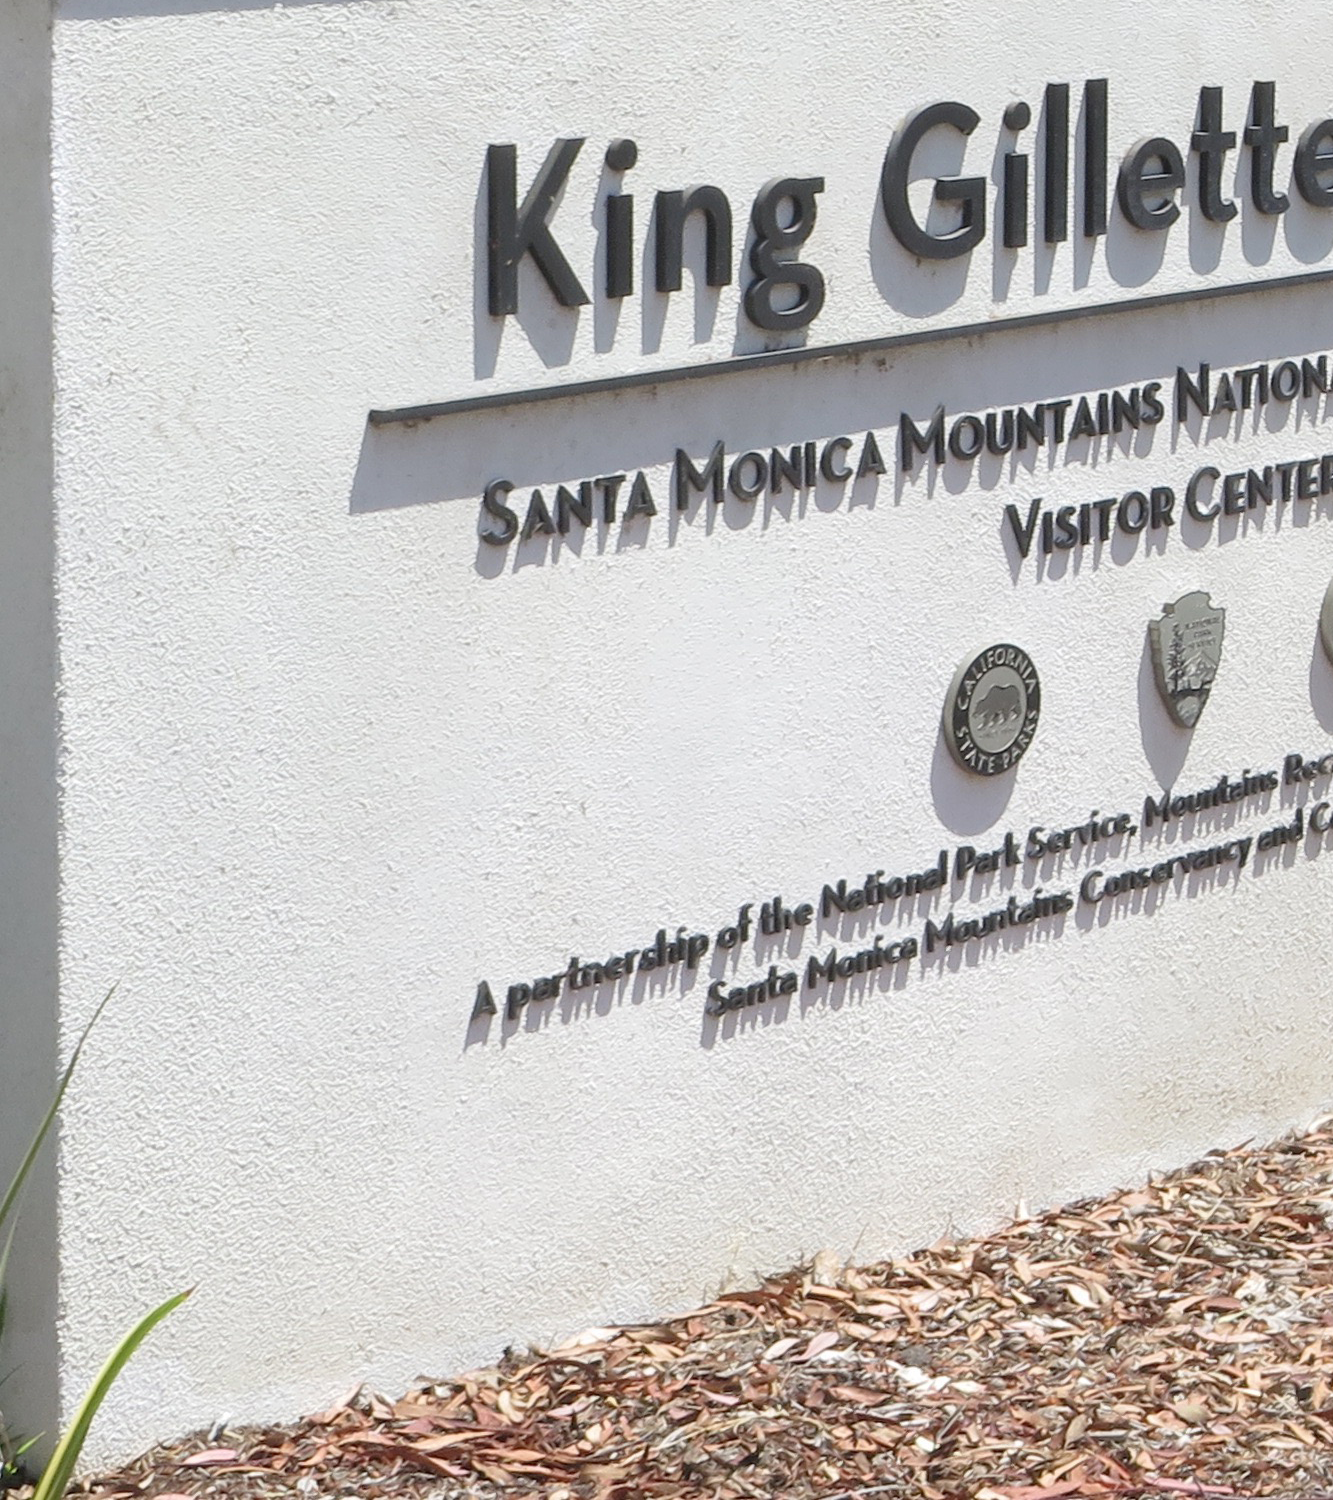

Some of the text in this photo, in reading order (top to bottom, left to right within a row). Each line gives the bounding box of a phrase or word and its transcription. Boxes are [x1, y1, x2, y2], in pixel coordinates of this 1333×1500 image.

[487, 136, 824, 332] King
[481, 470, 658, 546] SANTA
[674, 431, 887, 511] MONICA
[899, 382, 1165, 472] MOUNTAINS
[1005, 486, 1176, 559] VISITOR
[955, 710, 1038, 773] STATE PARKS
[957, 647, 1037, 710] CALIFORNIA
[471, 980, 497, 1020] A
[507, 926, 709, 1020] partnership
[716, 903, 754, 949] of
[760, 895, 813, 937] the
[822, 849, 948, 918] National
[955, 832, 1021, 881] Park
[1027, 809, 1138, 860] Service,
[1144, 769, 1279, 827] Mountains
[706, 965, 798, 1018] Santa
[807, 934, 918, 990] Monica
[925, 888, 1074, 953] Mountains
[1080, 836, 1254, 905] Conservancy
[1258, 808, 1304, 852] and
